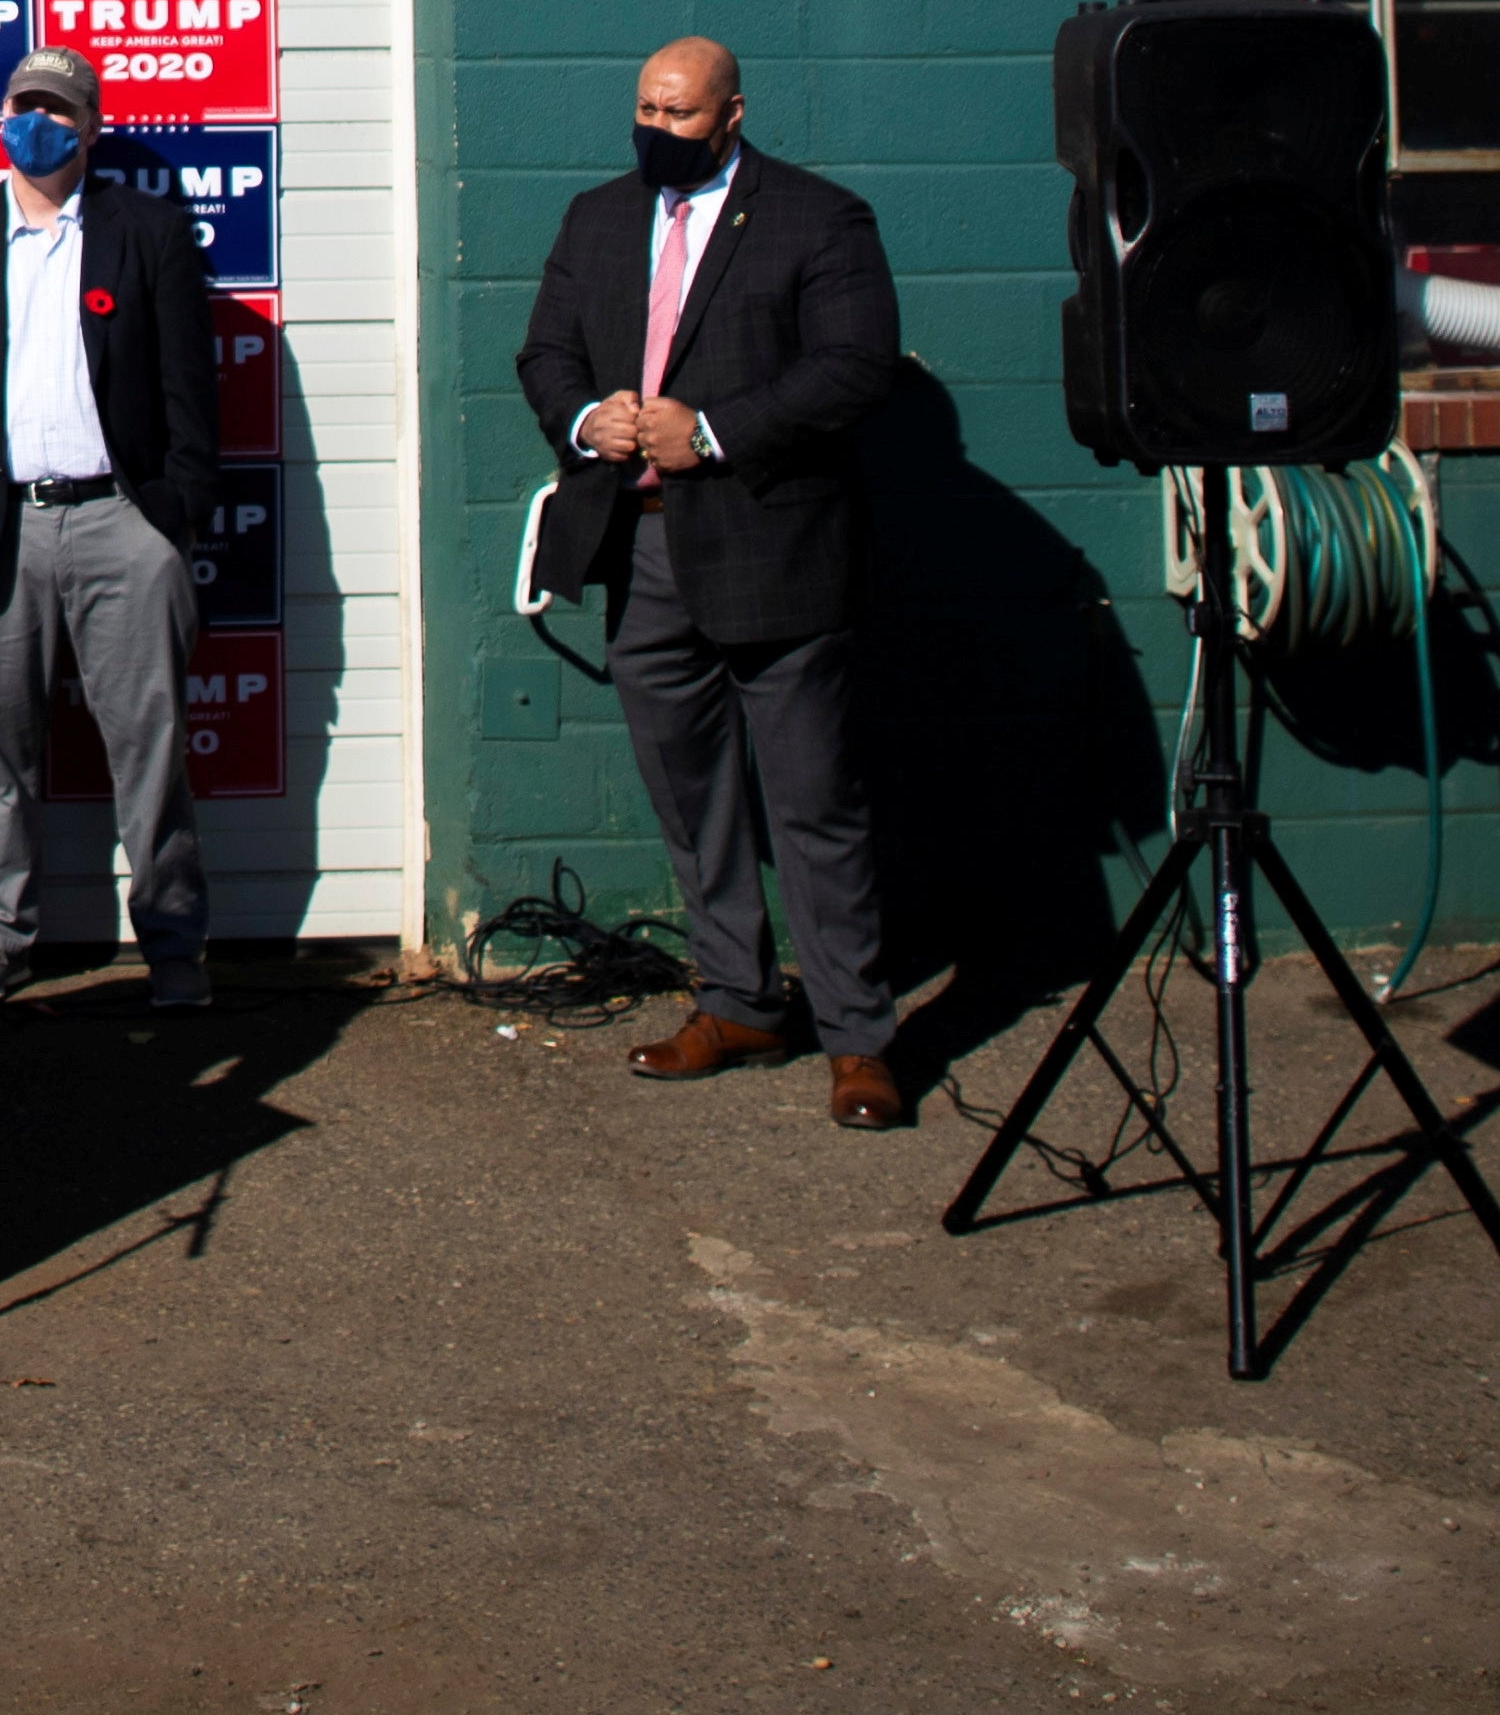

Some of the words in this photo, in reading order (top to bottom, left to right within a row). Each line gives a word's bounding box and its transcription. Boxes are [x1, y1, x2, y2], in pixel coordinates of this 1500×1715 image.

[91, 37, 121, 47] KEEP
[126, 36, 177, 46] AMERICA
[181, 35, 223, 46] GREAT!
[103, 53, 213, 80] 2020
